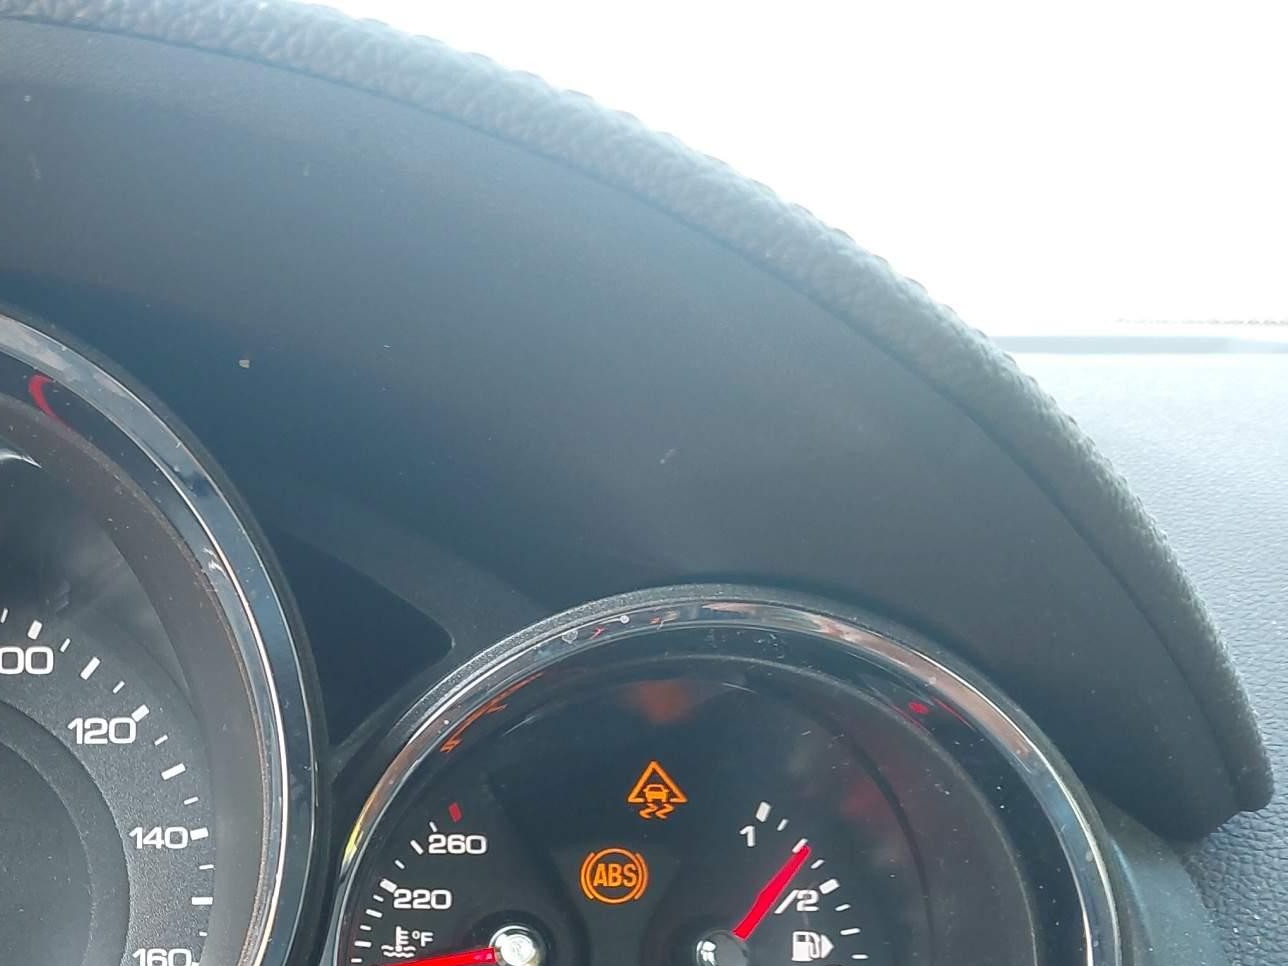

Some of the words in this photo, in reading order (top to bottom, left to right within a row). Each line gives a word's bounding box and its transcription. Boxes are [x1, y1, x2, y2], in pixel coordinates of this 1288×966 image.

[67, 716, 137, 745] 120
[128, 825, 189, 850] 140
[427, 834, 487, 855] 260
[739, 825, 756, 848] 1
[593, 863, 638, 888] ABS
[393, 889, 453, 910] 220
